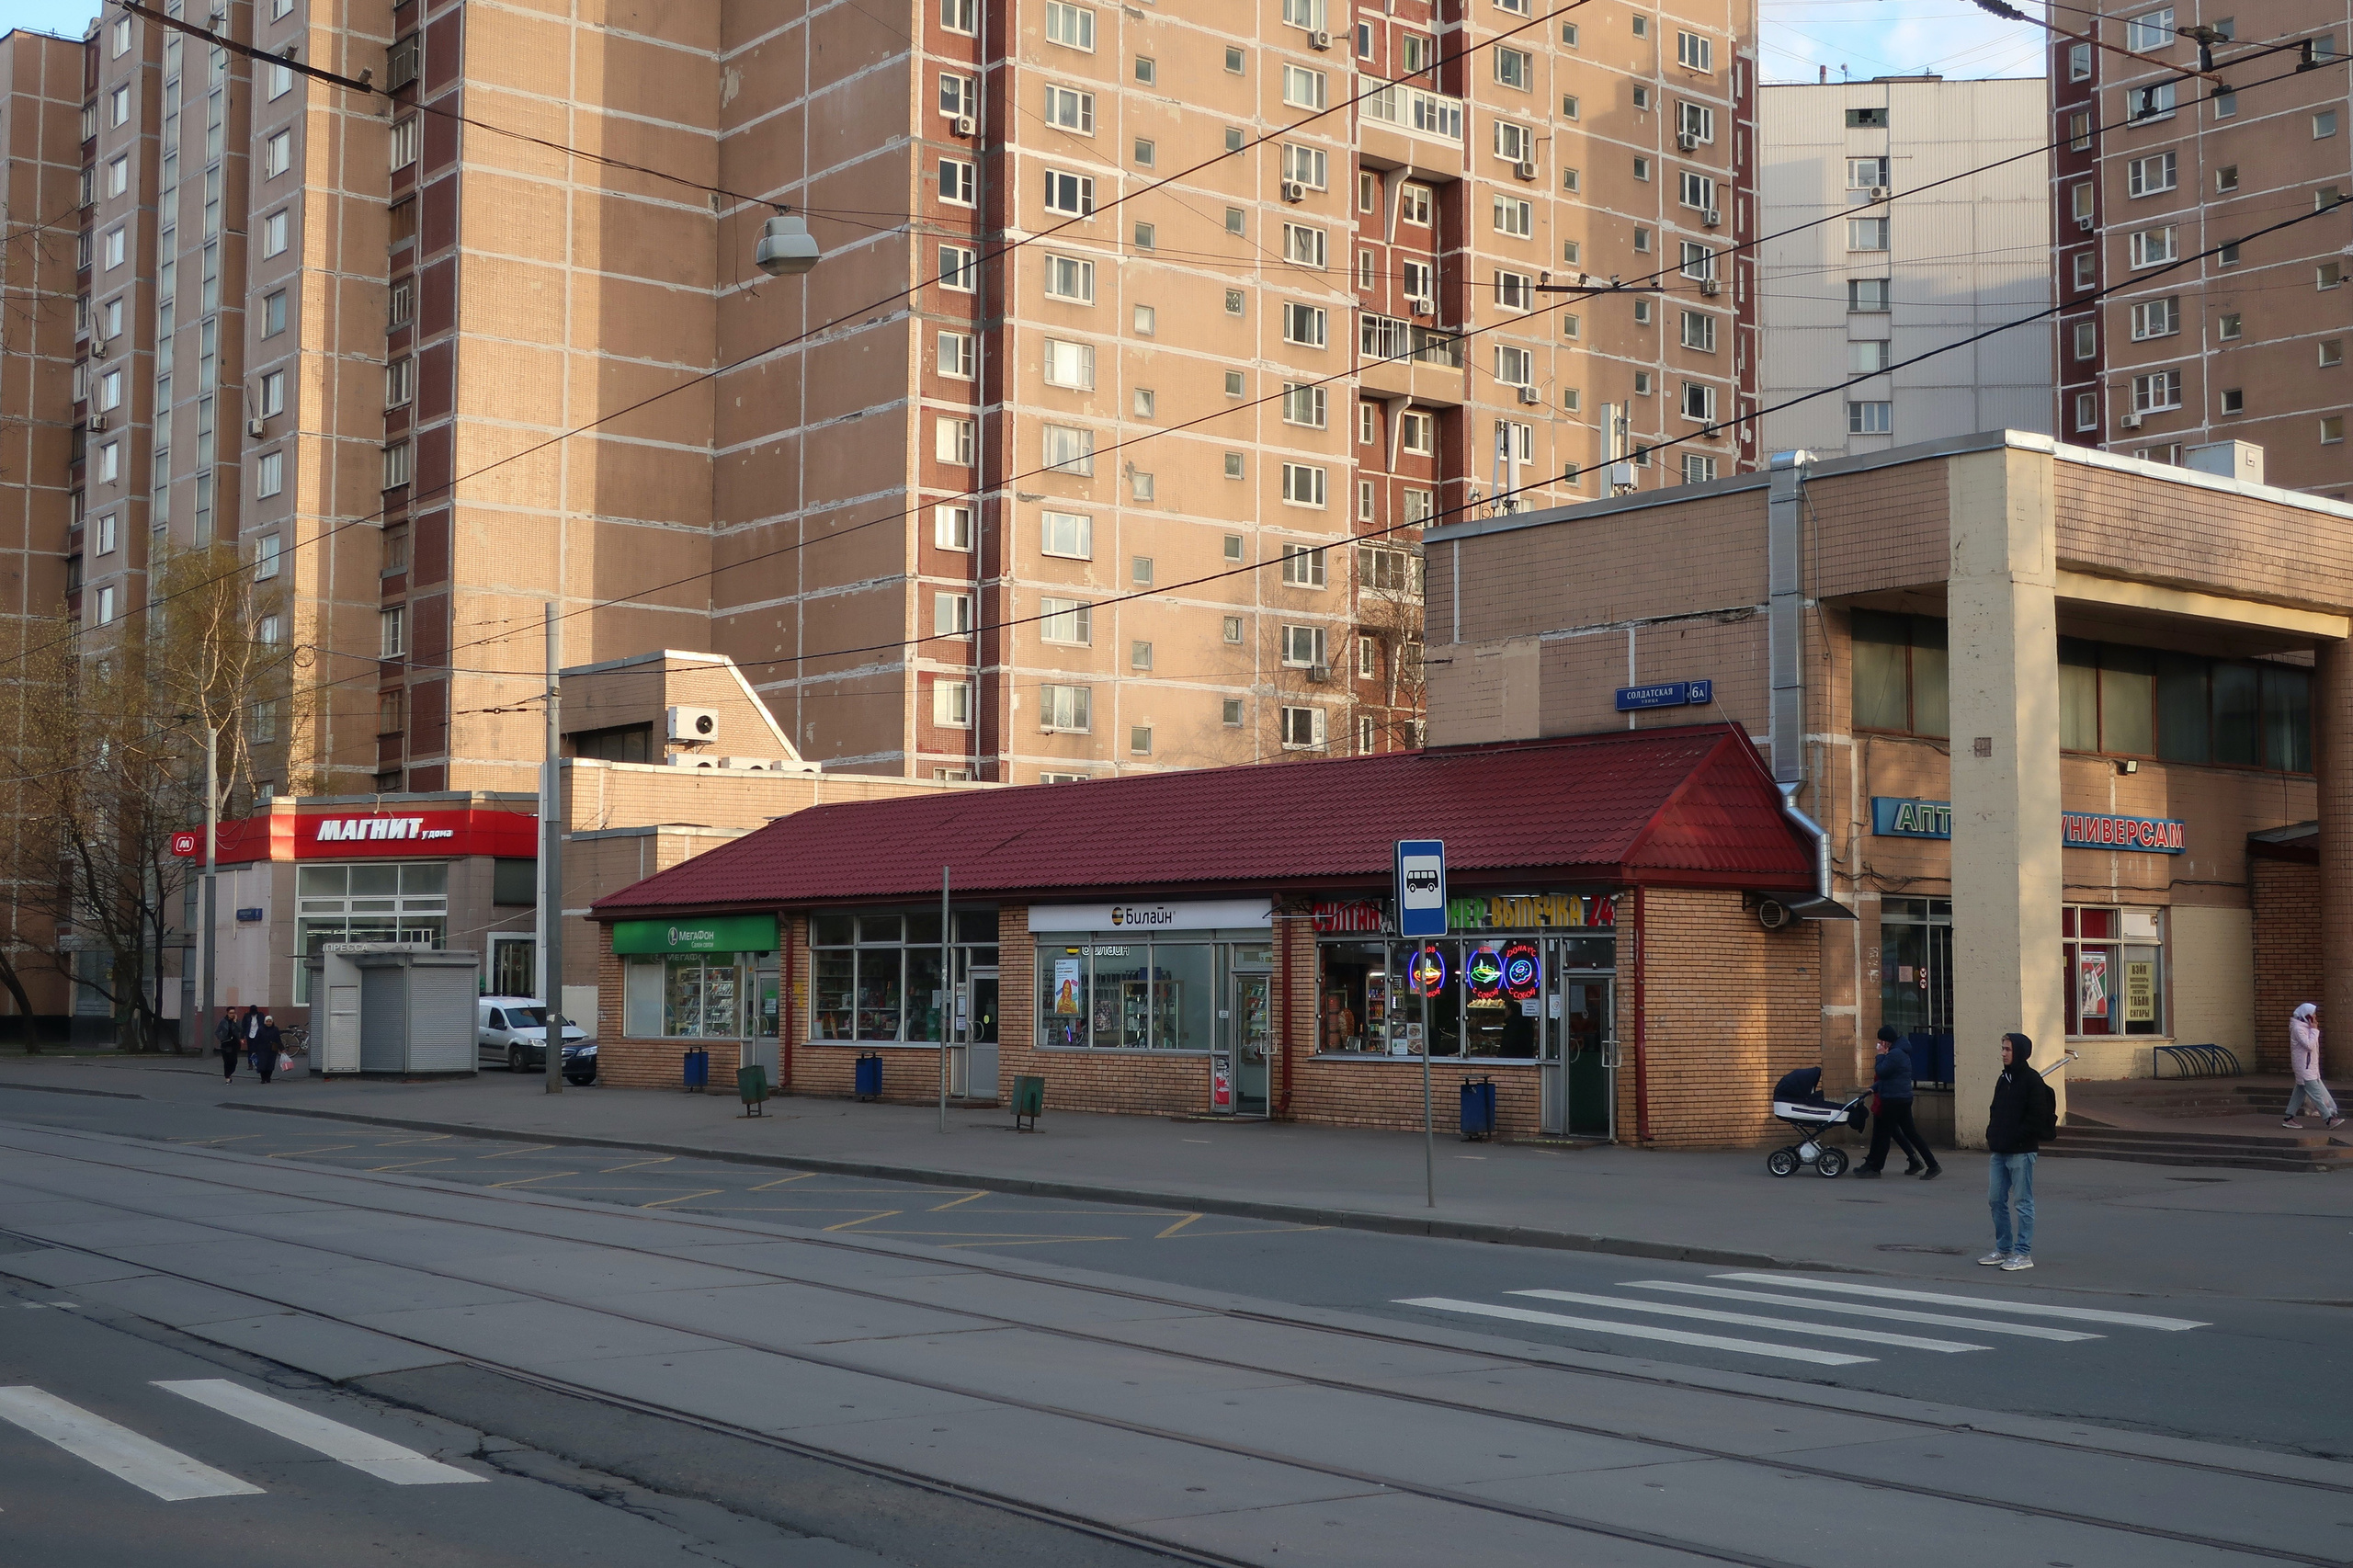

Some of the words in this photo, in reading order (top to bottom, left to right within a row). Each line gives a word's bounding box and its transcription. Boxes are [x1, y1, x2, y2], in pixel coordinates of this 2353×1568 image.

[1627, 687, 1673, 699] СОЛДАТСКАЯ
[1692, 687, 1704, 699] 6А
[1893, 803, 1951, 834] АПТ
[317, 818, 424, 841] МАГНИТ
[429, 830, 454, 839] дома
[1126, 906, 1172, 925] Билайн
[1312, 899, 1381, 931] СУЛТАН
[1447, 897, 1487, 928] НЕР
[1491, 894, 1585, 927] ВЫПЕЧКА
[1587, 894, 1614, 926] 24
[325, 943, 368, 952] ПРЕССА
[2131, 963, 2147, 974] ВЭЙП
[1477, 987, 1499, 999] СОБОЙ
[1513, 987, 1536, 1000] СОБОЙ
[2130, 995, 2149, 1006] ТАБАК
[2130, 1009, 2150, 1018] СИГАРЫ
